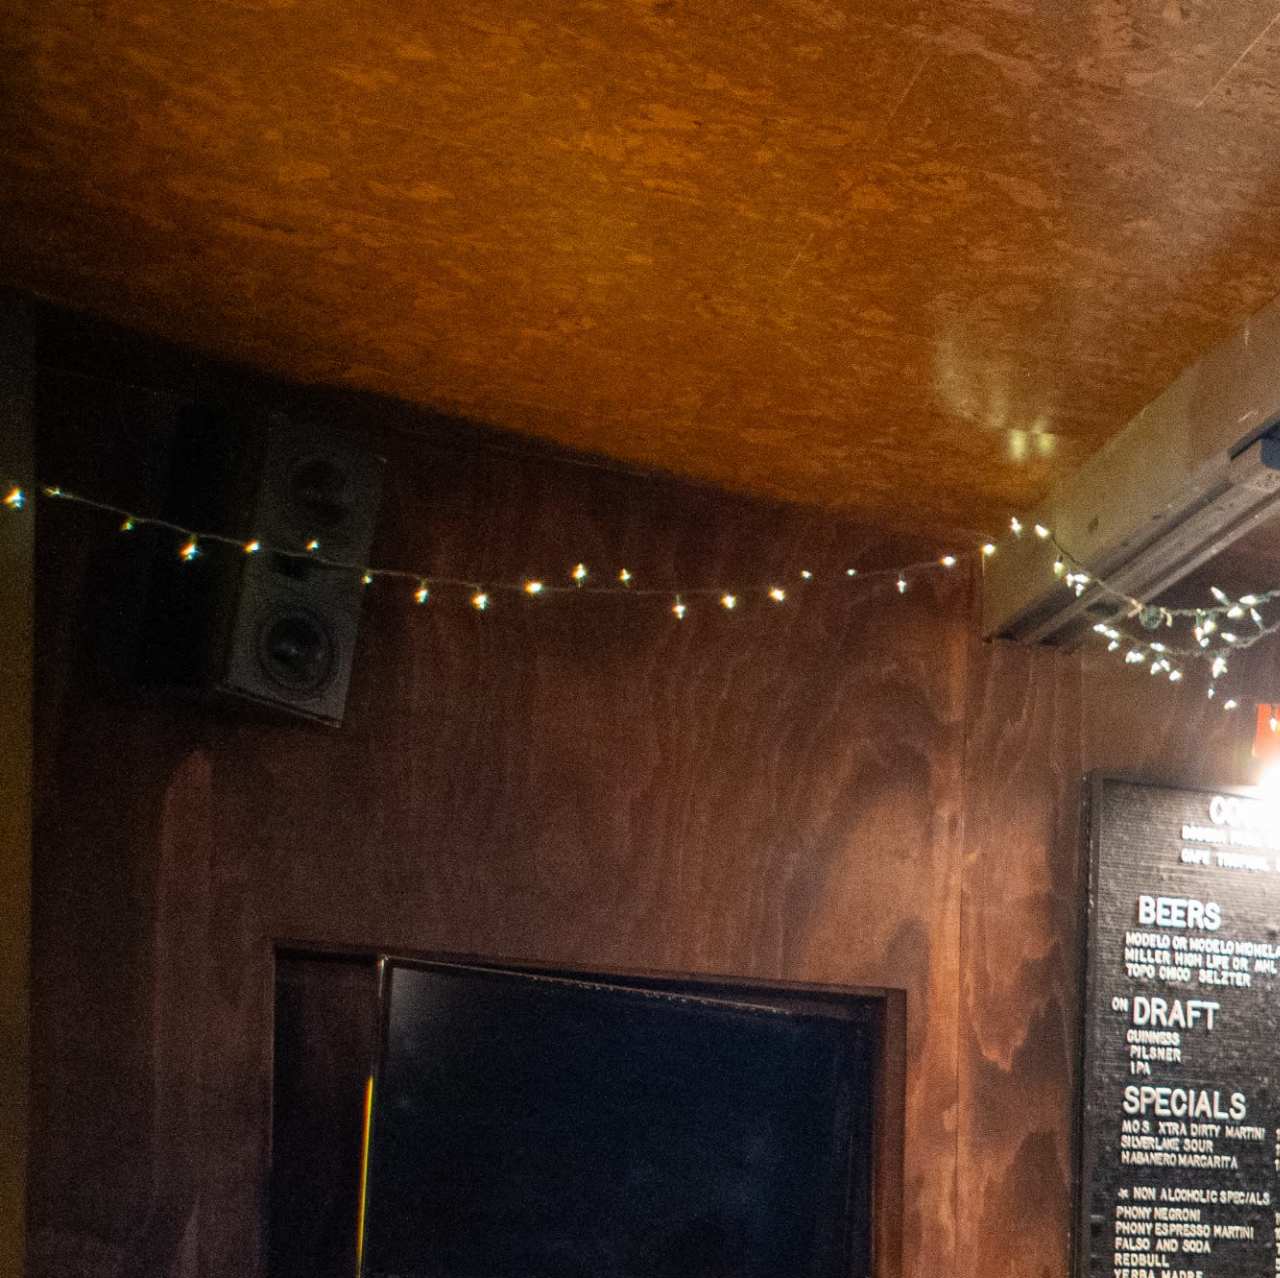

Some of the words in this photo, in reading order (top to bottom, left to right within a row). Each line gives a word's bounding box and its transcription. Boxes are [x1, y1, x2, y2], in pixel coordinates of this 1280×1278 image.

[1138, 895, 1222, 931] BEERS
[1125, 931, 1170, 949] MODELO
[1172, 935, 1188, 951] OR
[1124, 947, 1171, 964] MILLER
[1174, 951, 1202, 968] HIGH
[1206, 954, 1230, 970] LIFE
[1232, 956, 1249, 972] OR
[1125, 962, 1155, 979] TOPO
[1159, 965, 1191, 982] CHICO
[1111, 996, 1129, 1013] ON
[1132, 995, 1221, 1031] DRAFT
[1126, 1028, 1181, 1047] GUINNESS
[1130, 1044, 1182, 1062] PILSNER
[1130, 1060, 1151, 1075] IPA
[1122, 1085, 1247, 1121] SPECIALS
[1158, 1121, 1187, 1137] XTRA
[1190, 1123, 1221, 1138] DIRTY
[1225, 1125, 1266, 1141] MARTINI
[1120, 1135, 1180, 1151] SILVERLAKE
[1183, 1138, 1214, 1153] SOUR
[1121, 1151, 1177, 1167] HABANERO
[1178, 1154, 1239, 1170] MARGARITA
[1133, 1186, 1157, 1200] NON
[1160, 1187, 1218, 1203] ALCOHOLIC
[1116, 1205, 1152, 1220] PHONY
[1154, 1207, 1201, 1222] NEGRONI
[1115, 1221, 1152, 1235] PHONY
[1154, 1222, 1211, 1238] ESPRESSO
[1213, 1225, 1254, 1240] MARTINI
[1114, 1236, 1150, 1251] FALSO
[1155, 1238, 1179, 1252] AND
[1181, 1239, 1212, 1254] SODA
[1114, 1252, 1170, 1268] REDBULL
